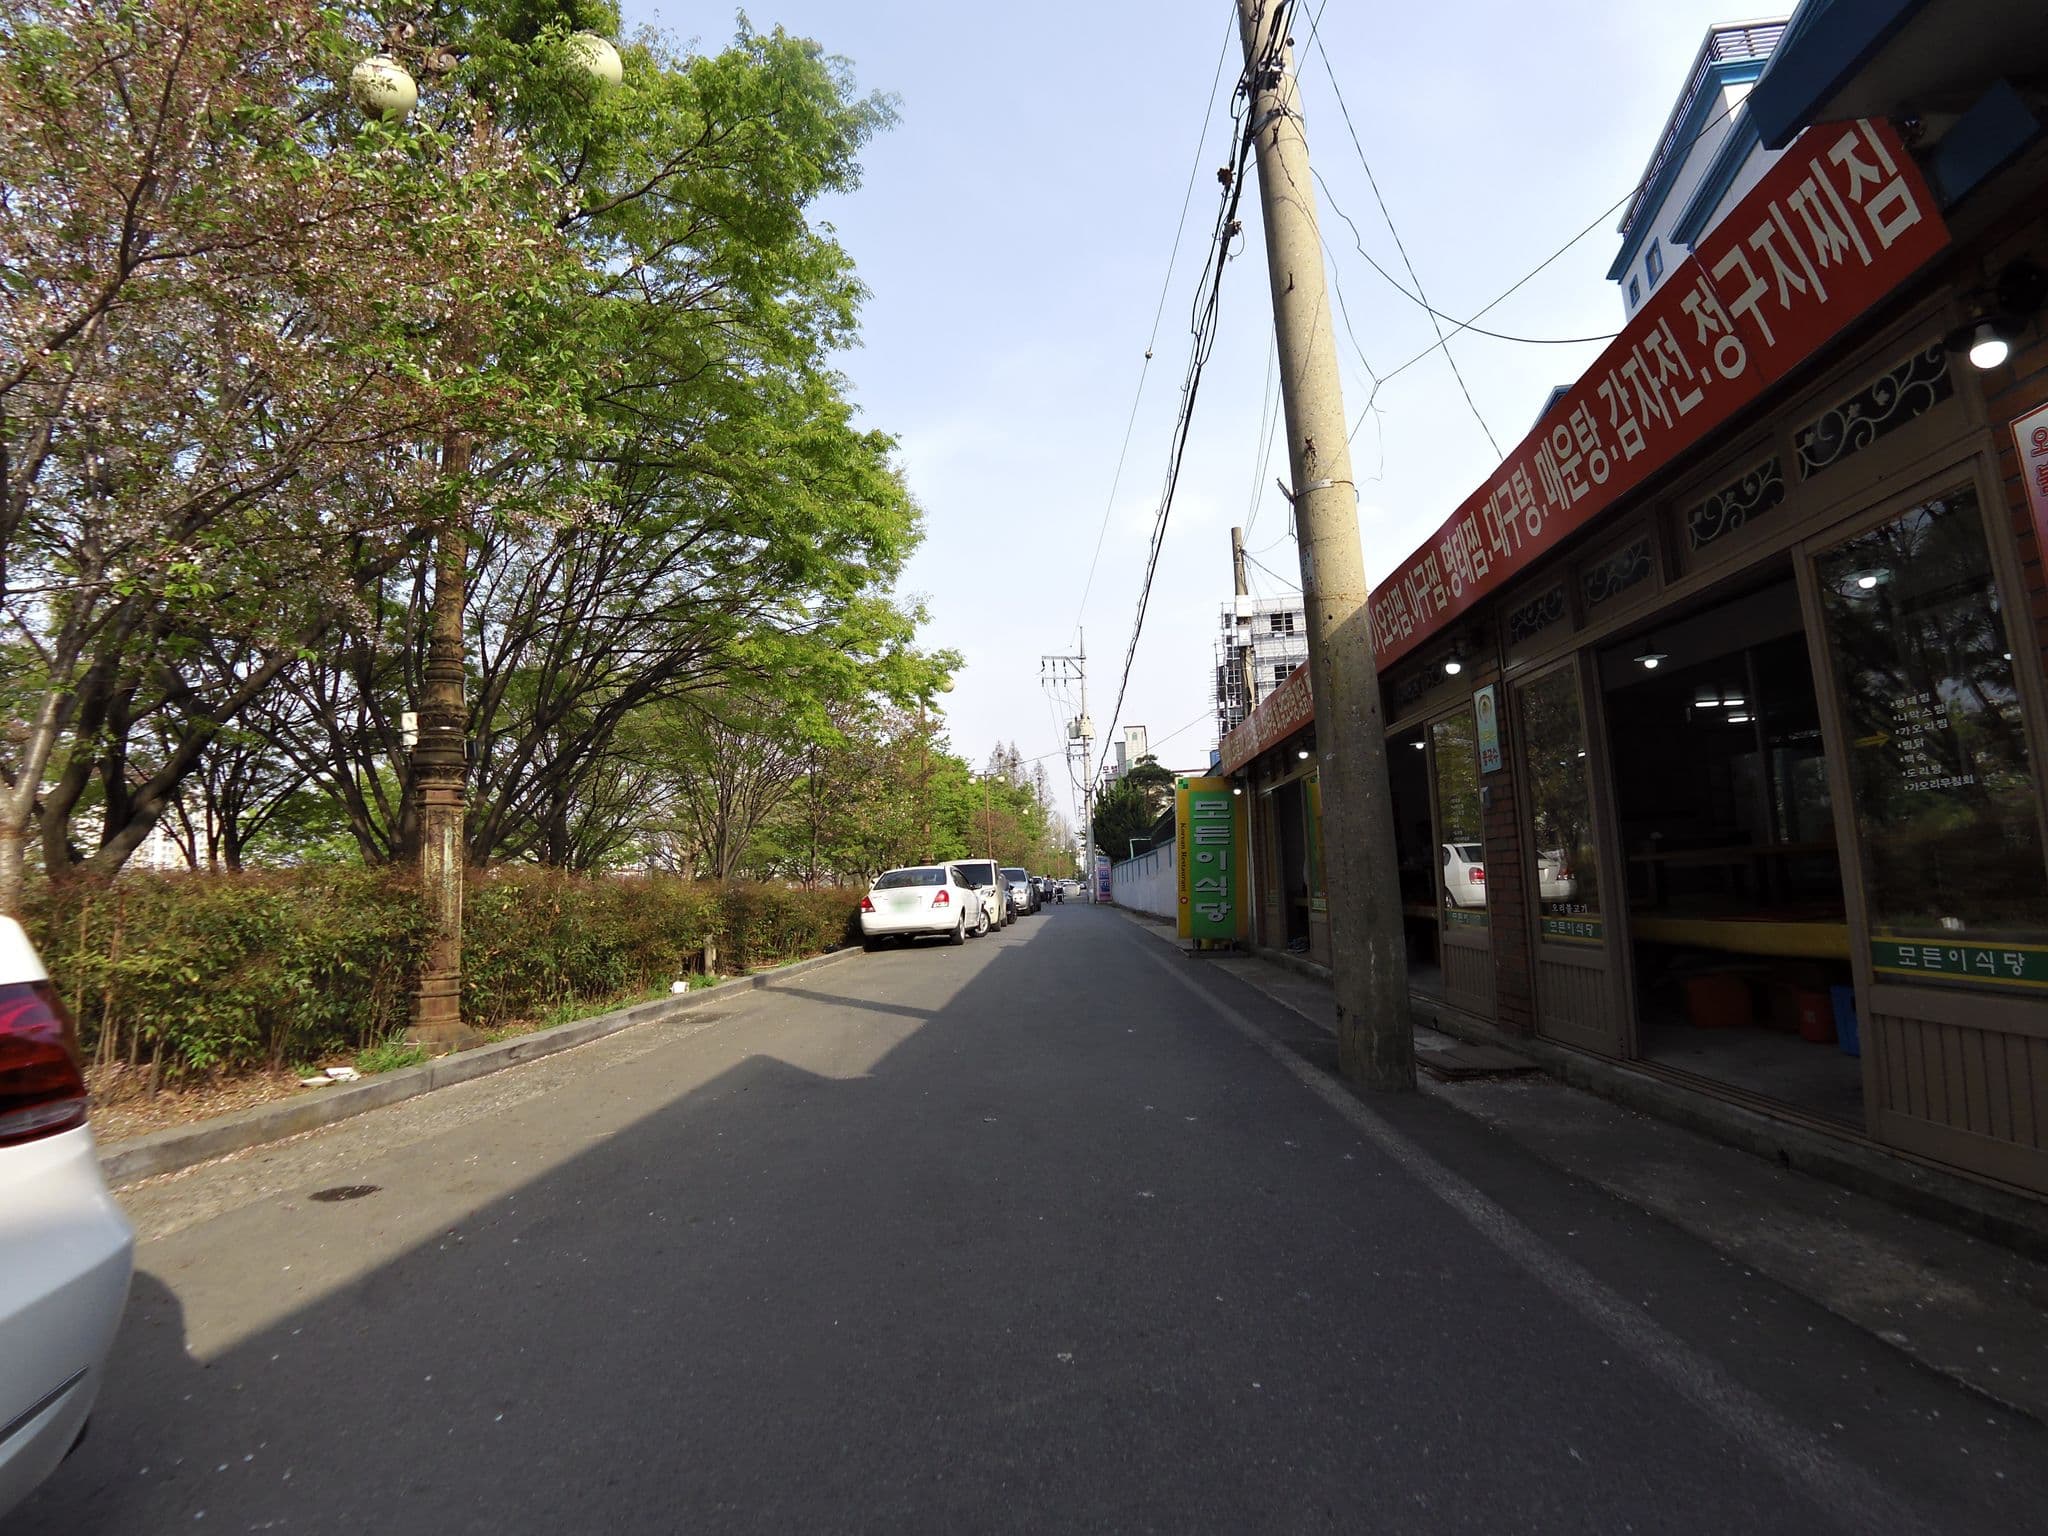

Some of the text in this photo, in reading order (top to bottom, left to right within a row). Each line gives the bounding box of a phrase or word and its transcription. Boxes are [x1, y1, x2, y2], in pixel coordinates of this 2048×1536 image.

[1680, 118, 1922, 379] 정구지찌짐
[1900, 719, 1948, 735] 가오리찜
[1194, 800, 1232, 922] 모든이식당
[1551, 902, 1588, 915] 오리불고기
[1550, 921, 1594, 937] 모든이식당
[1898, 945, 2026, 977] 모든이식당
